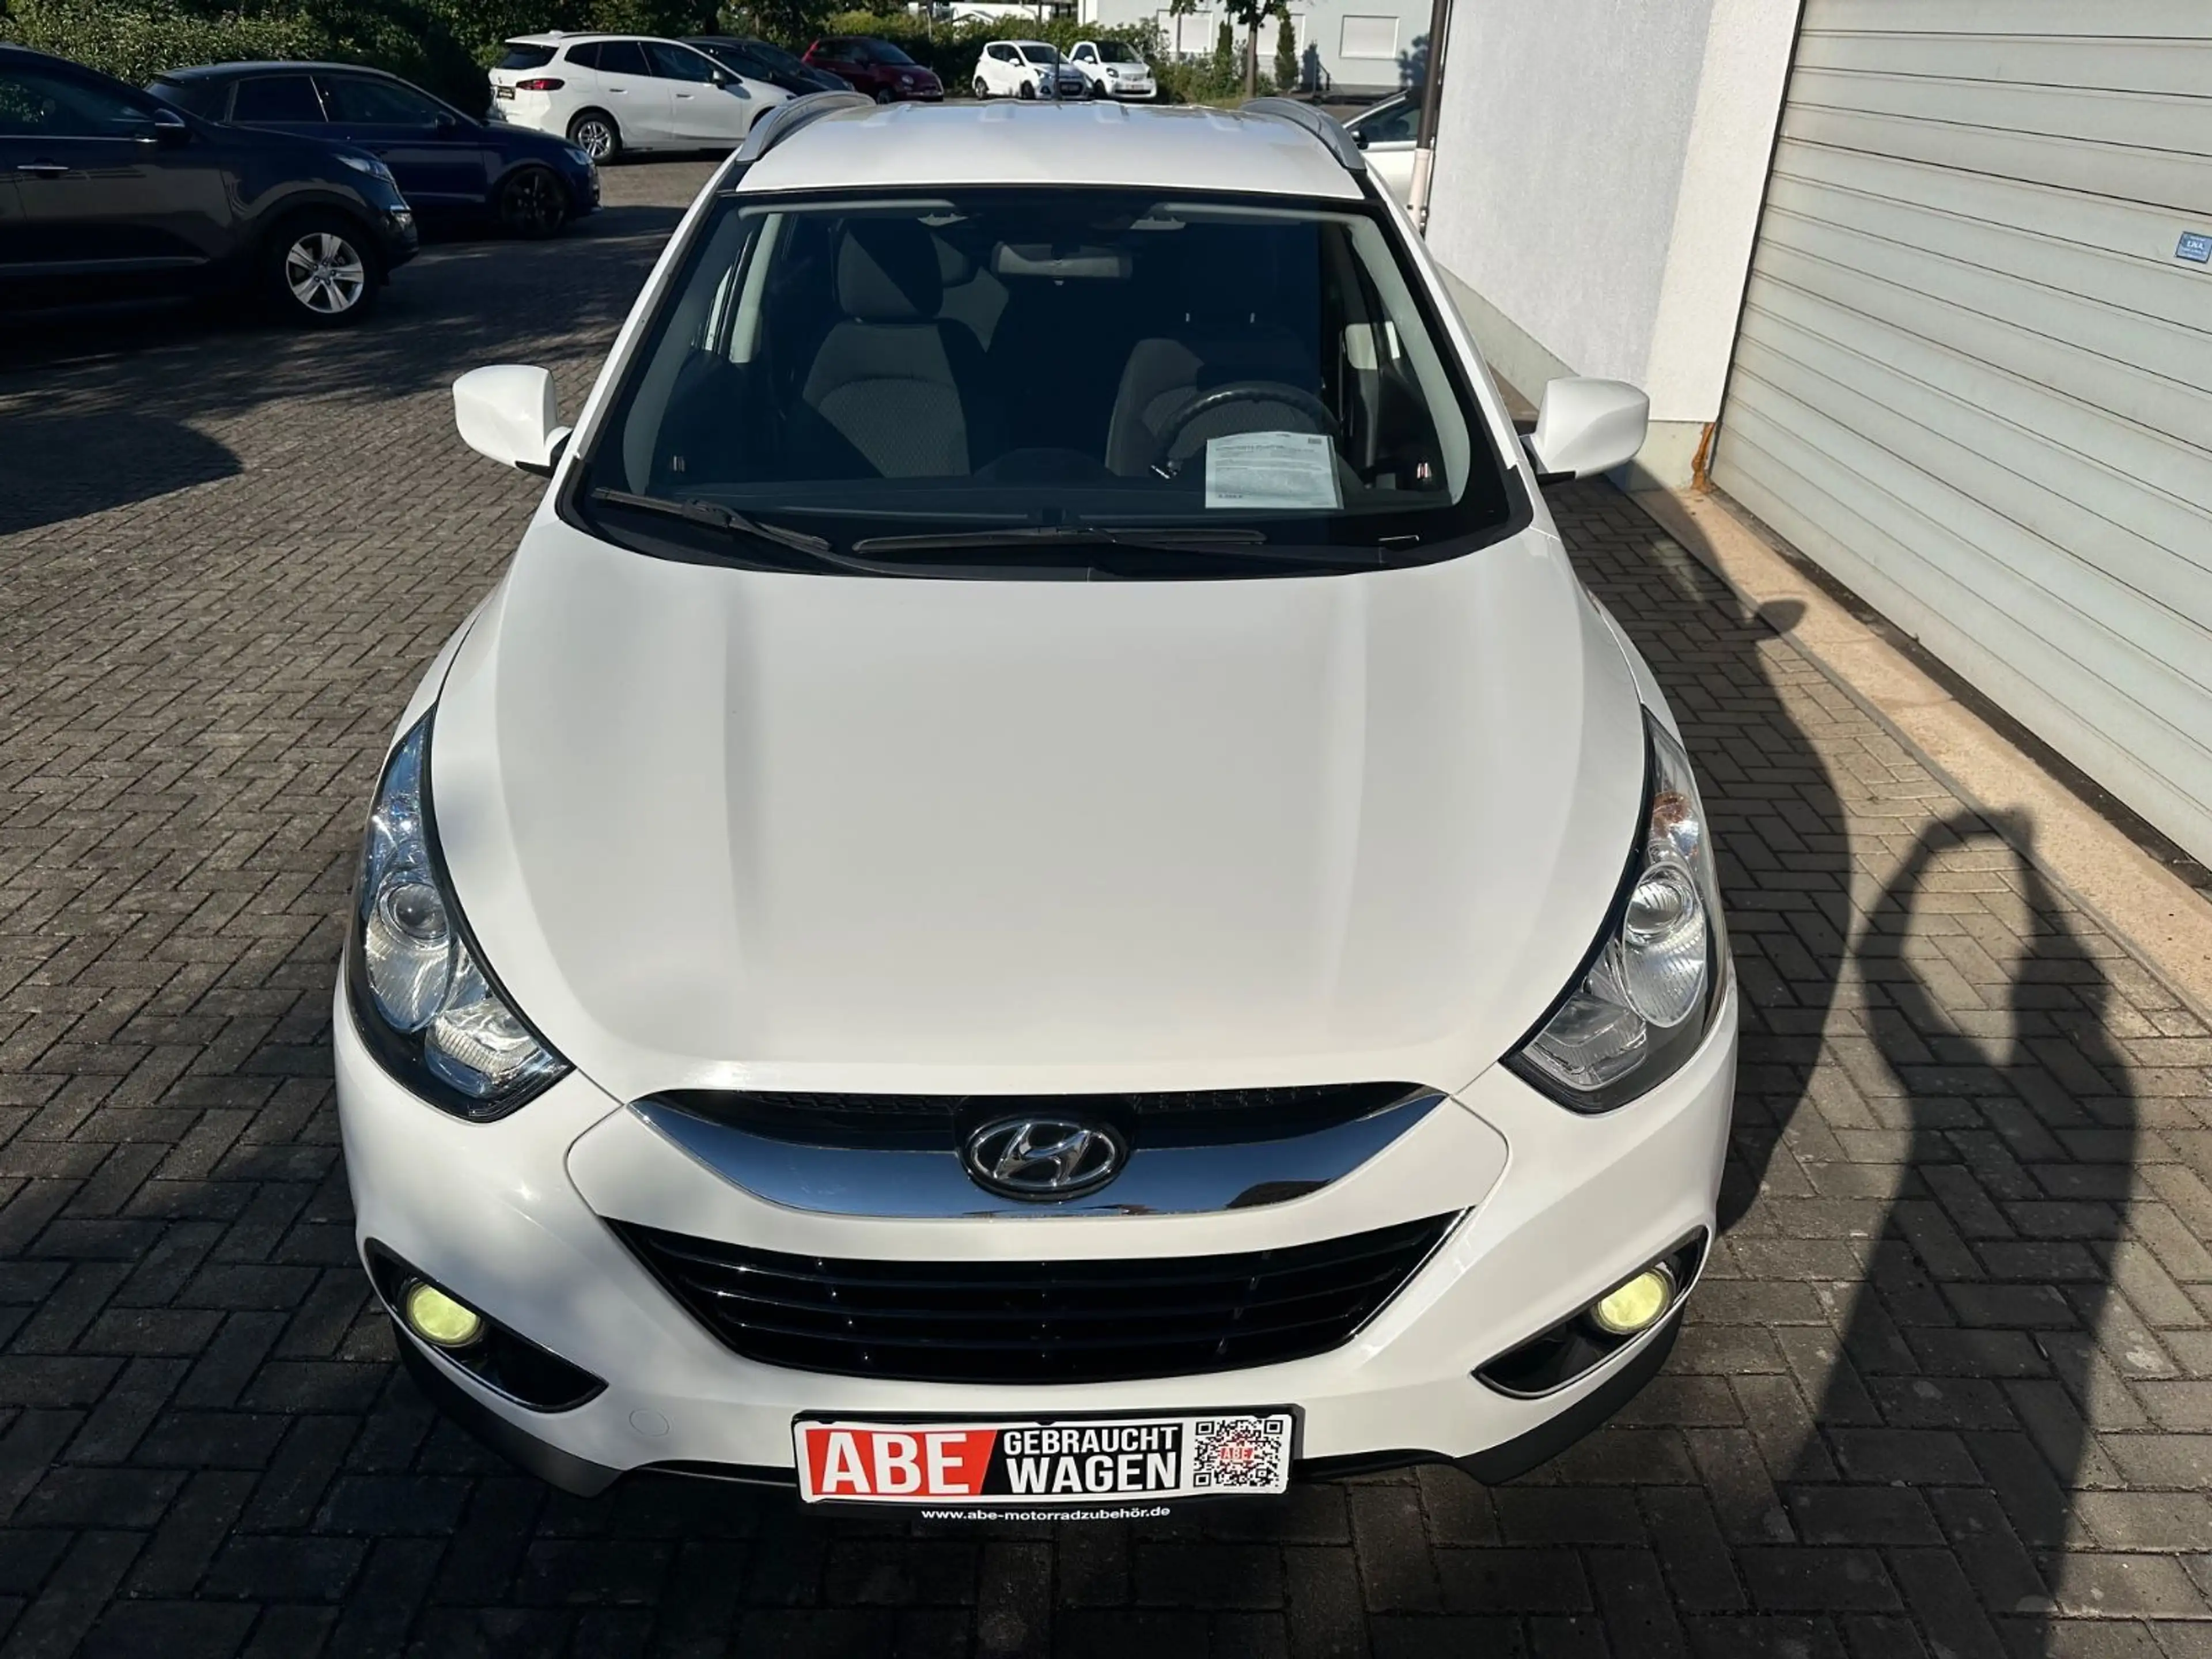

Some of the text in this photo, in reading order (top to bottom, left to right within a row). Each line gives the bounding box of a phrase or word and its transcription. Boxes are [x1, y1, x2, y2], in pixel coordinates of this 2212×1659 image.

[1003, 1426, 1179, 1455] GEBRAUCHT
[1222, 1448, 1250, 1460] ABE
[822, 1432, 970, 1494] ABE
[1006, 1452, 1177, 1494] WAGEN
[921, 1507, 1171, 1521] www.abe-motorradzubehör.de
